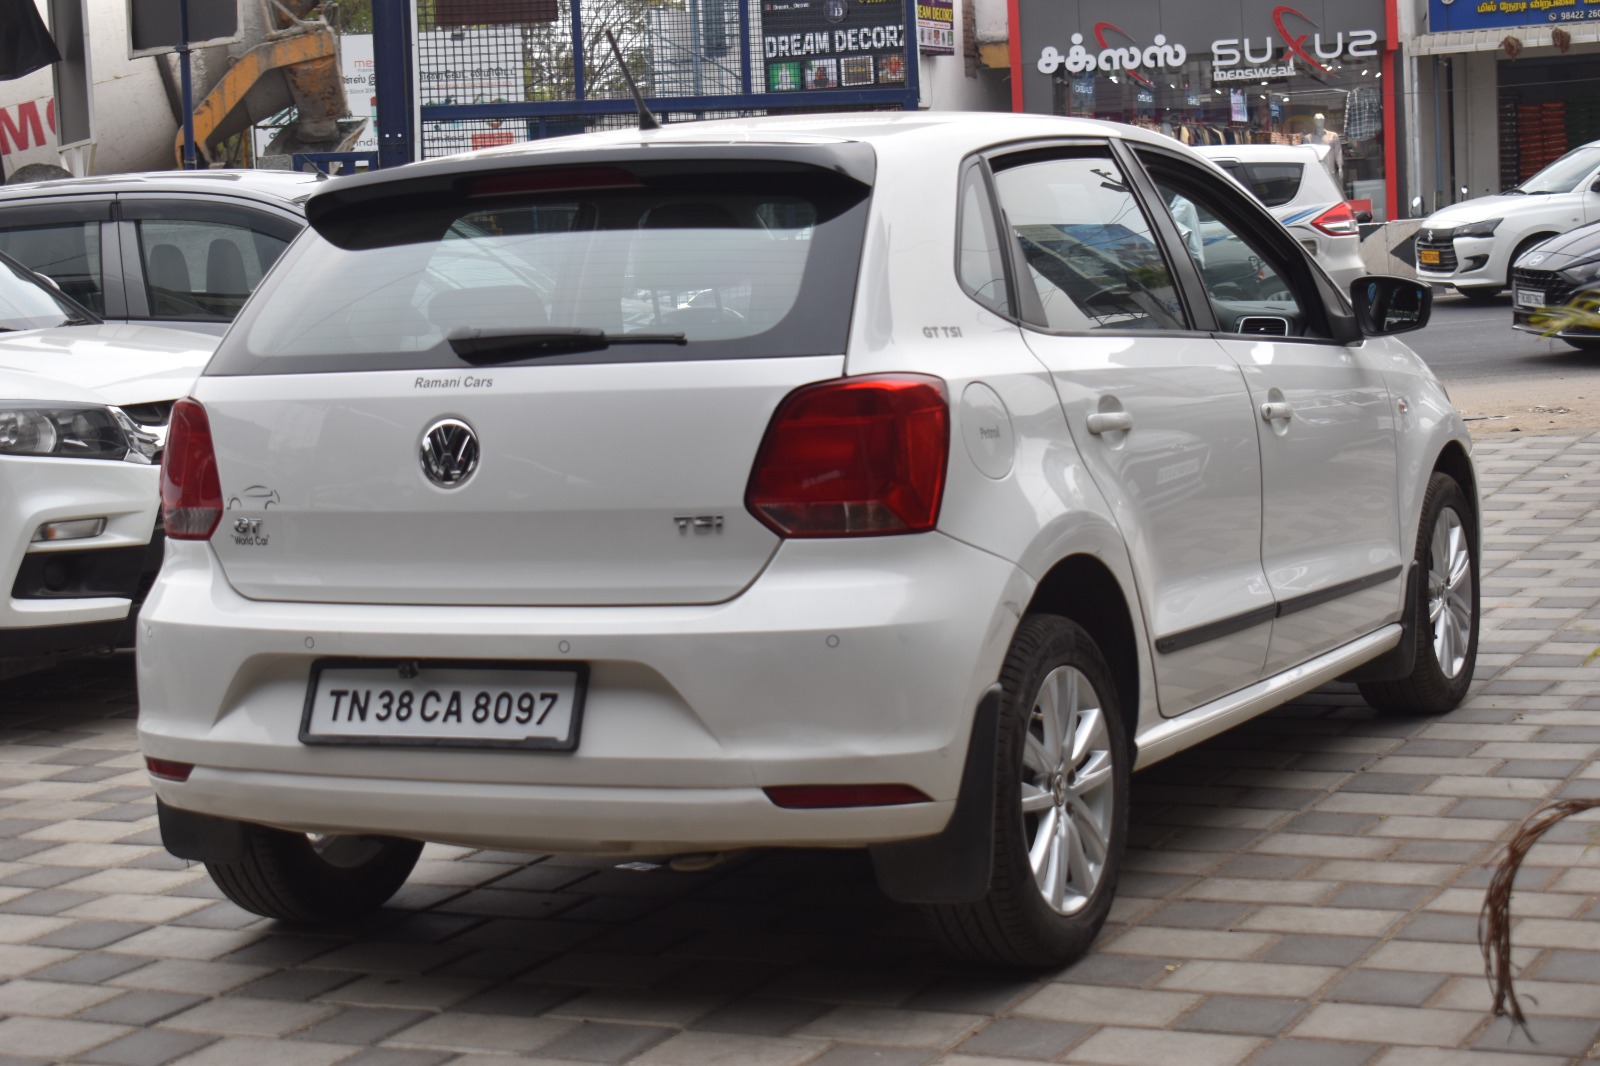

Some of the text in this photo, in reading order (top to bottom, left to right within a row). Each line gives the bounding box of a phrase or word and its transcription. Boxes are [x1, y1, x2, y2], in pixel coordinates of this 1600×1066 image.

[1561, 11, 1585, 20] 98422
[765, 31, 830, 58] DREAM
[1037, 33, 1187, 74] சக்ஸஸ்
[922, 326, 963, 338] GT TSI
[414, 376, 493, 388] Ramani Cars
[979, 425, 1001, 439] Petrol
[234, 517, 263, 535] GT
[673, 514, 725, 533] TSI
[471, 691, 559, 726] 8097
